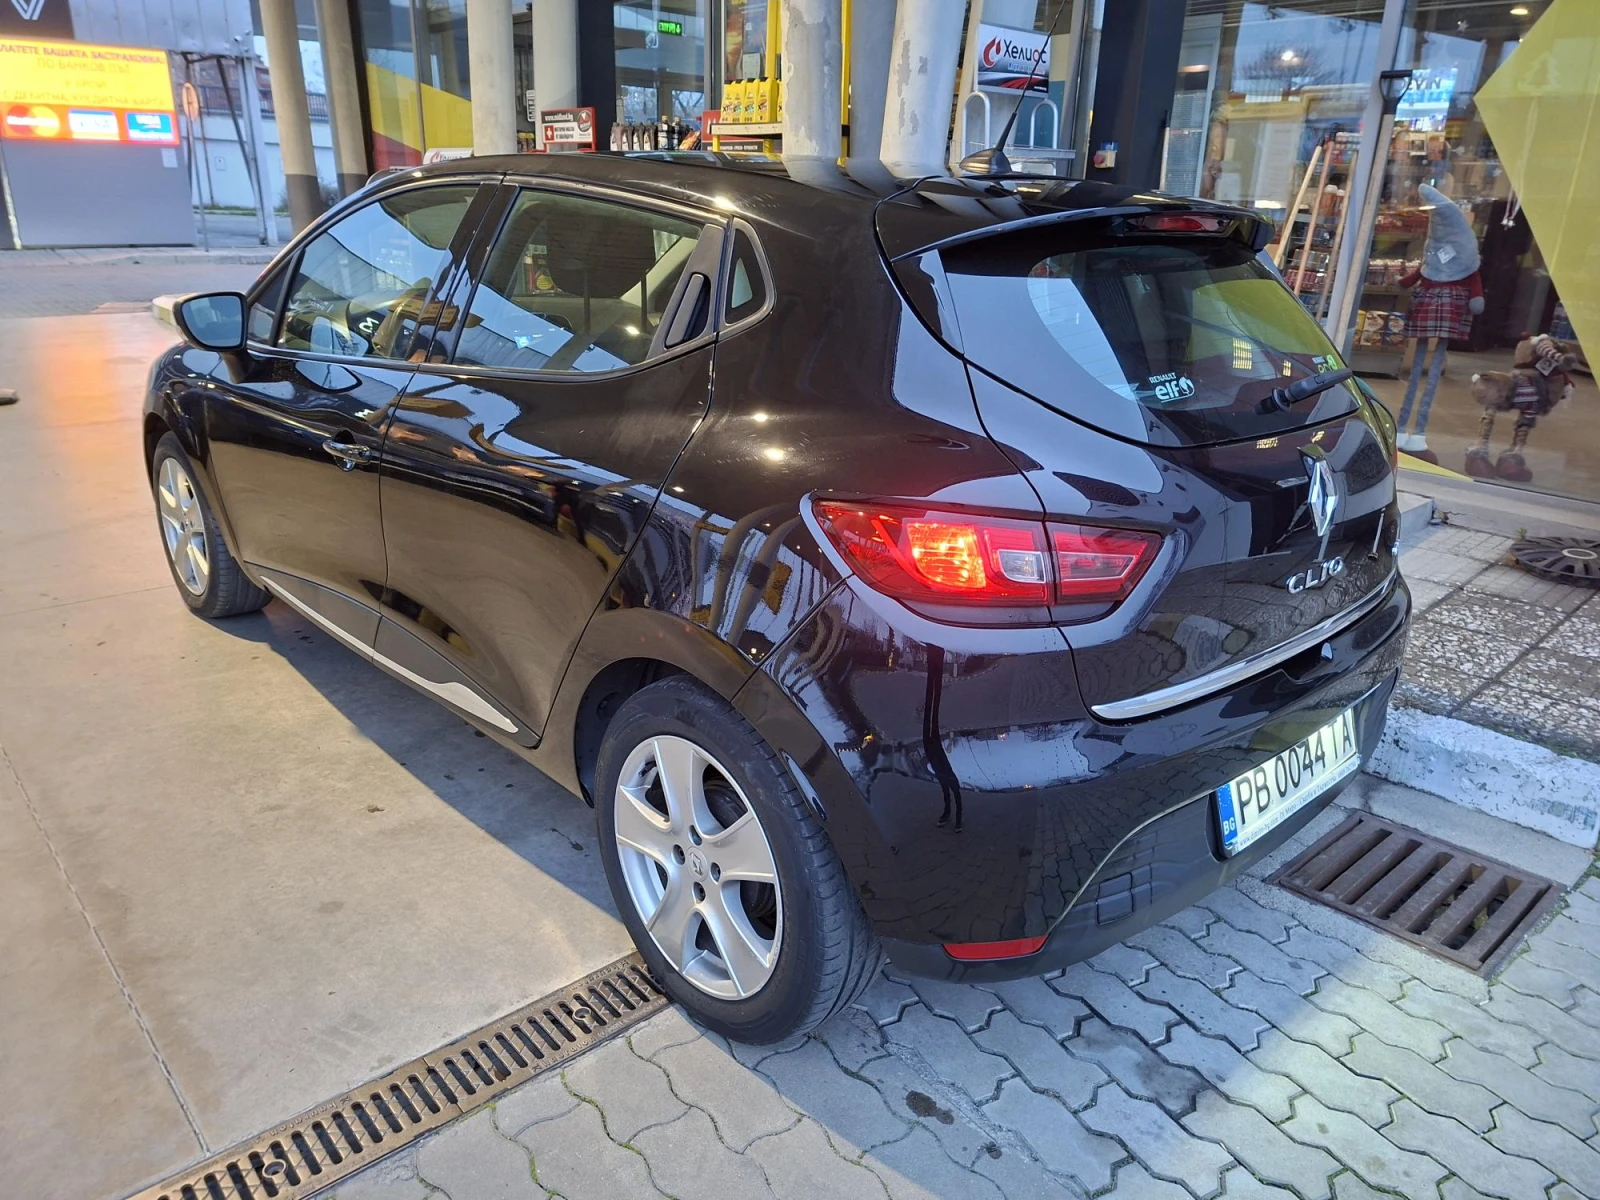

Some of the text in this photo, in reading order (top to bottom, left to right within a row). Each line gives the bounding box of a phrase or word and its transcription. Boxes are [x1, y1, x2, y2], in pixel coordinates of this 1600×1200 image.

[1003, 39, 1047, 63] Хелиос
[1149, 372, 1177, 384] RENAULT
[1155, 380, 1179, 400] elf
[1286, 556, 1343, 594] CLIO
[1236, 766, 1270, 825] PB
[1275, 732, 1325, 798] 0044
[1223, 816, 1236, 836] BG
